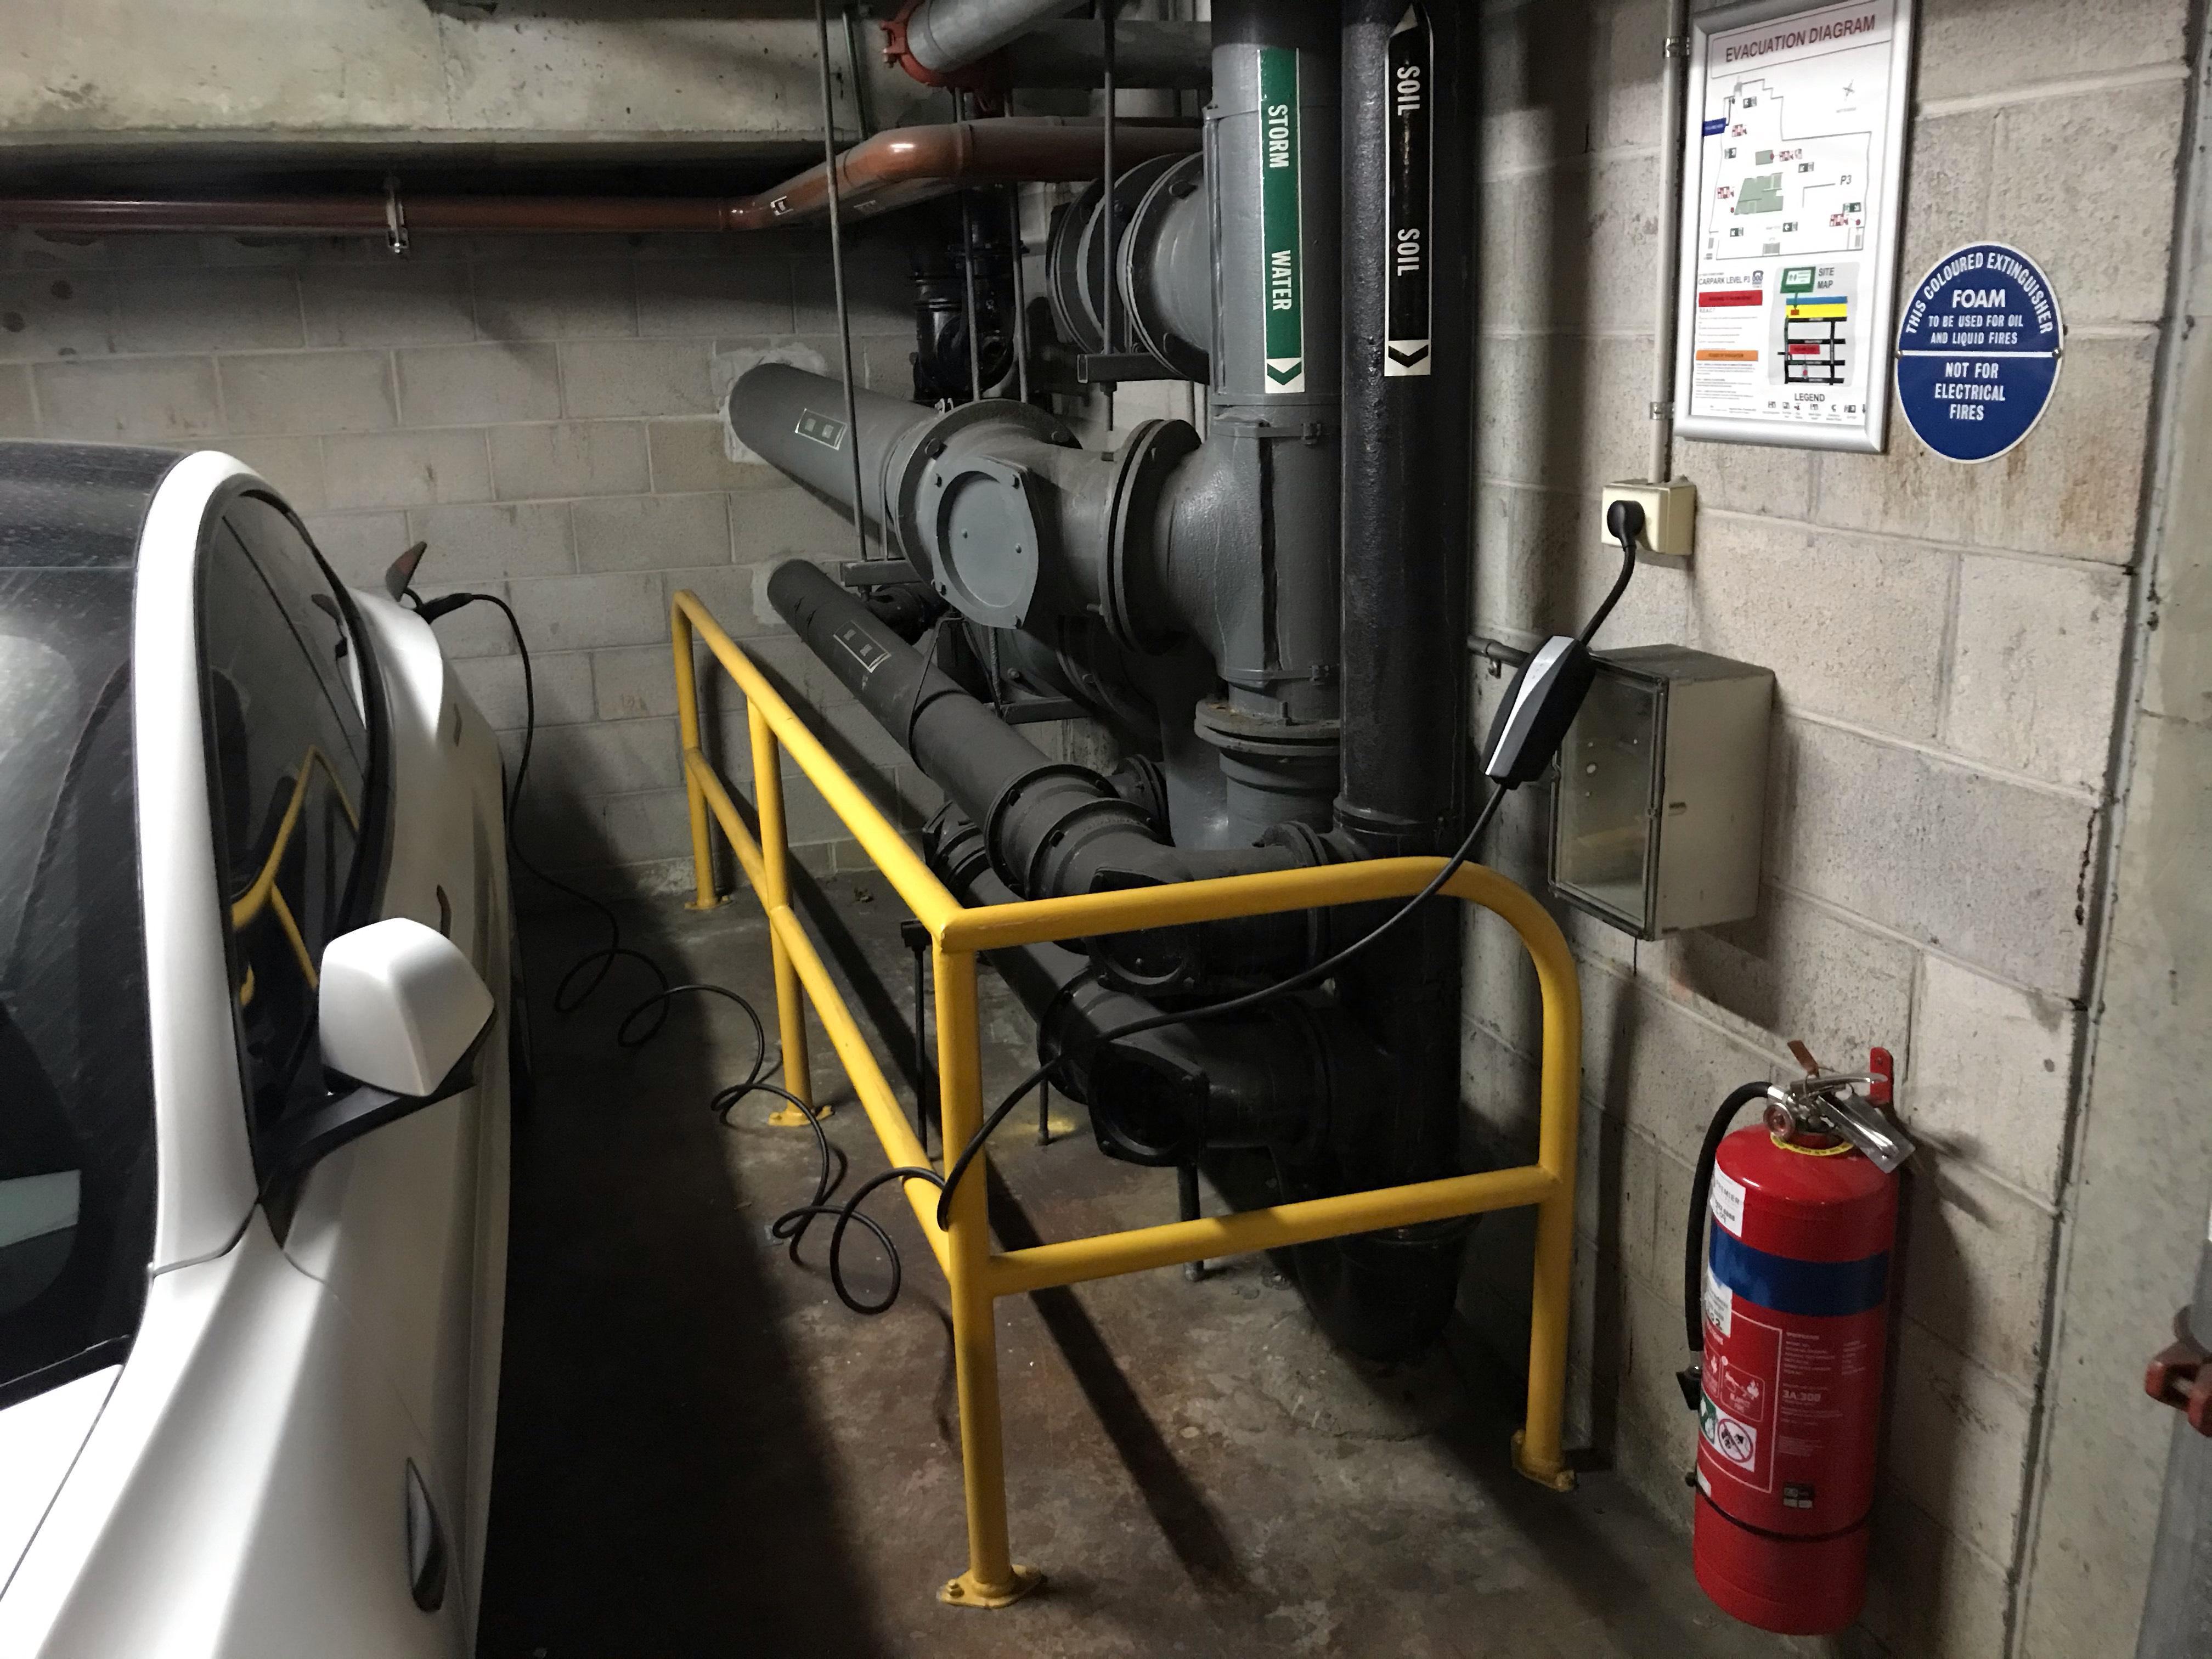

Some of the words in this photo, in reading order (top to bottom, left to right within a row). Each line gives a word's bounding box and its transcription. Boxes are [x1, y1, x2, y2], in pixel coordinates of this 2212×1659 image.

[1725, 30, 1807, 63] EVACUATION
[1809, 14, 1876, 44] DIAGRAM
[1397, 65, 1420, 116] SOIL
[1268, 104, 1290, 168] STORM
[1840, 174, 1852, 185] P3
[1397, 228, 1420, 276] SOIL
[1271, 250, 1292, 311] WATER
[1818, 267, 1835, 276] SITE
[1699, 277, 1725, 285] CARPARK
[1817, 280, 1833, 289] MAP
[1905, 300, 1926, 334] THIS
[1923, 252, 1983, 300] COLOURED
[1987, 252, 2053, 334] EXTINGUISHER
[1953, 289, 2005, 308] FOAM
[1928, 315, 1939, 328] TO
[1942, 315, 1954, 328] BE
[1958, 315, 1983, 327] USED
[1986, 314, 2005, 327] FOR
[2008, 314, 2023, 327] OIL
[1931, 332, 1948, 345] AND
[1952, 331, 1984, 347] LIQUID
[1988, 331, 2018, 345] FIRES
[1945, 362, 1970, 378] NOT
[1974, 362, 1999, 379] FOR
[1794, 393, 1825, 402] LEGEND
[1934, 383, 2006, 401] ELECTRICAL
[1949, 403, 1984, 421] FIRES
